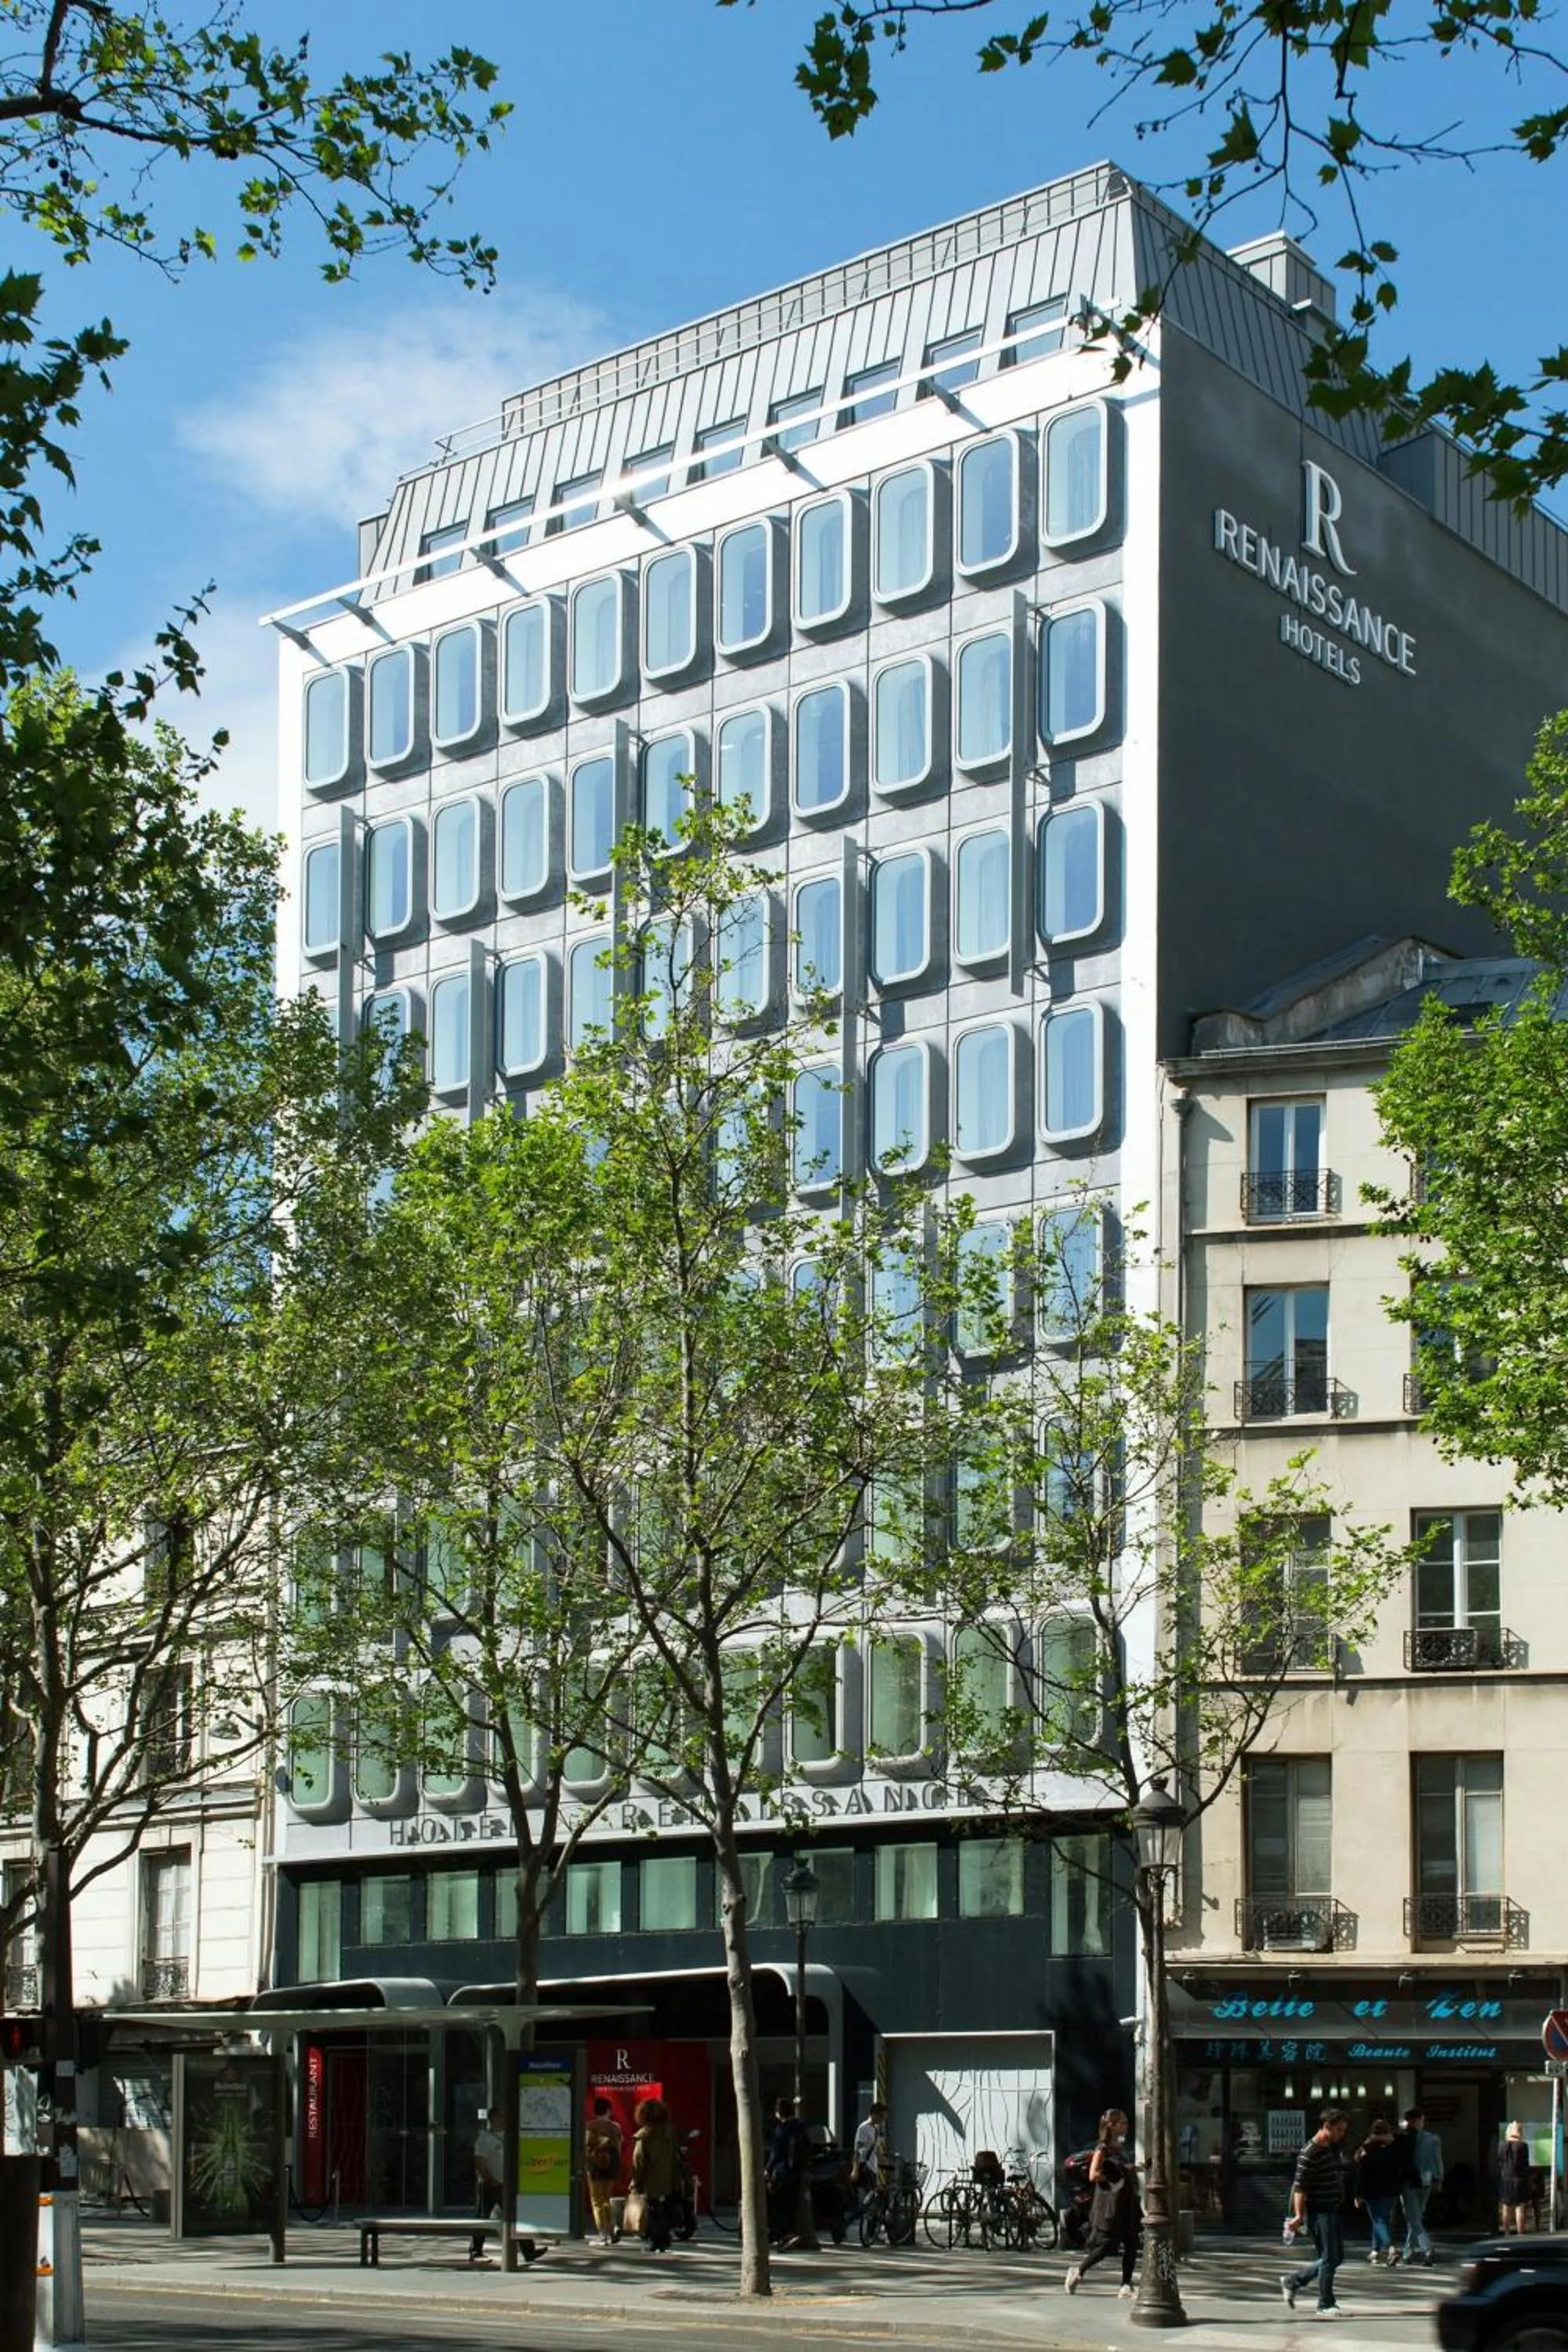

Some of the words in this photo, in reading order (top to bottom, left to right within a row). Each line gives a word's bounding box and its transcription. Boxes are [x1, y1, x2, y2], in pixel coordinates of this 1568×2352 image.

[1301, 459, 1358, 576] R
[1214, 508, 1417, 677] RENAISSANCE
[1279, 613, 1361, 686] HOTELS
[622, 1781, 971, 1828] REISSANCE
[1353, 1998, 1390, 2019] et
[615, 2047, 632, 2071] R
[1425, 2043, 1498, 2059] Institut
[307, 2058, 318, 2138] RESTAURANT
[590, 2072, 655, 2084] RENAISSANCE
